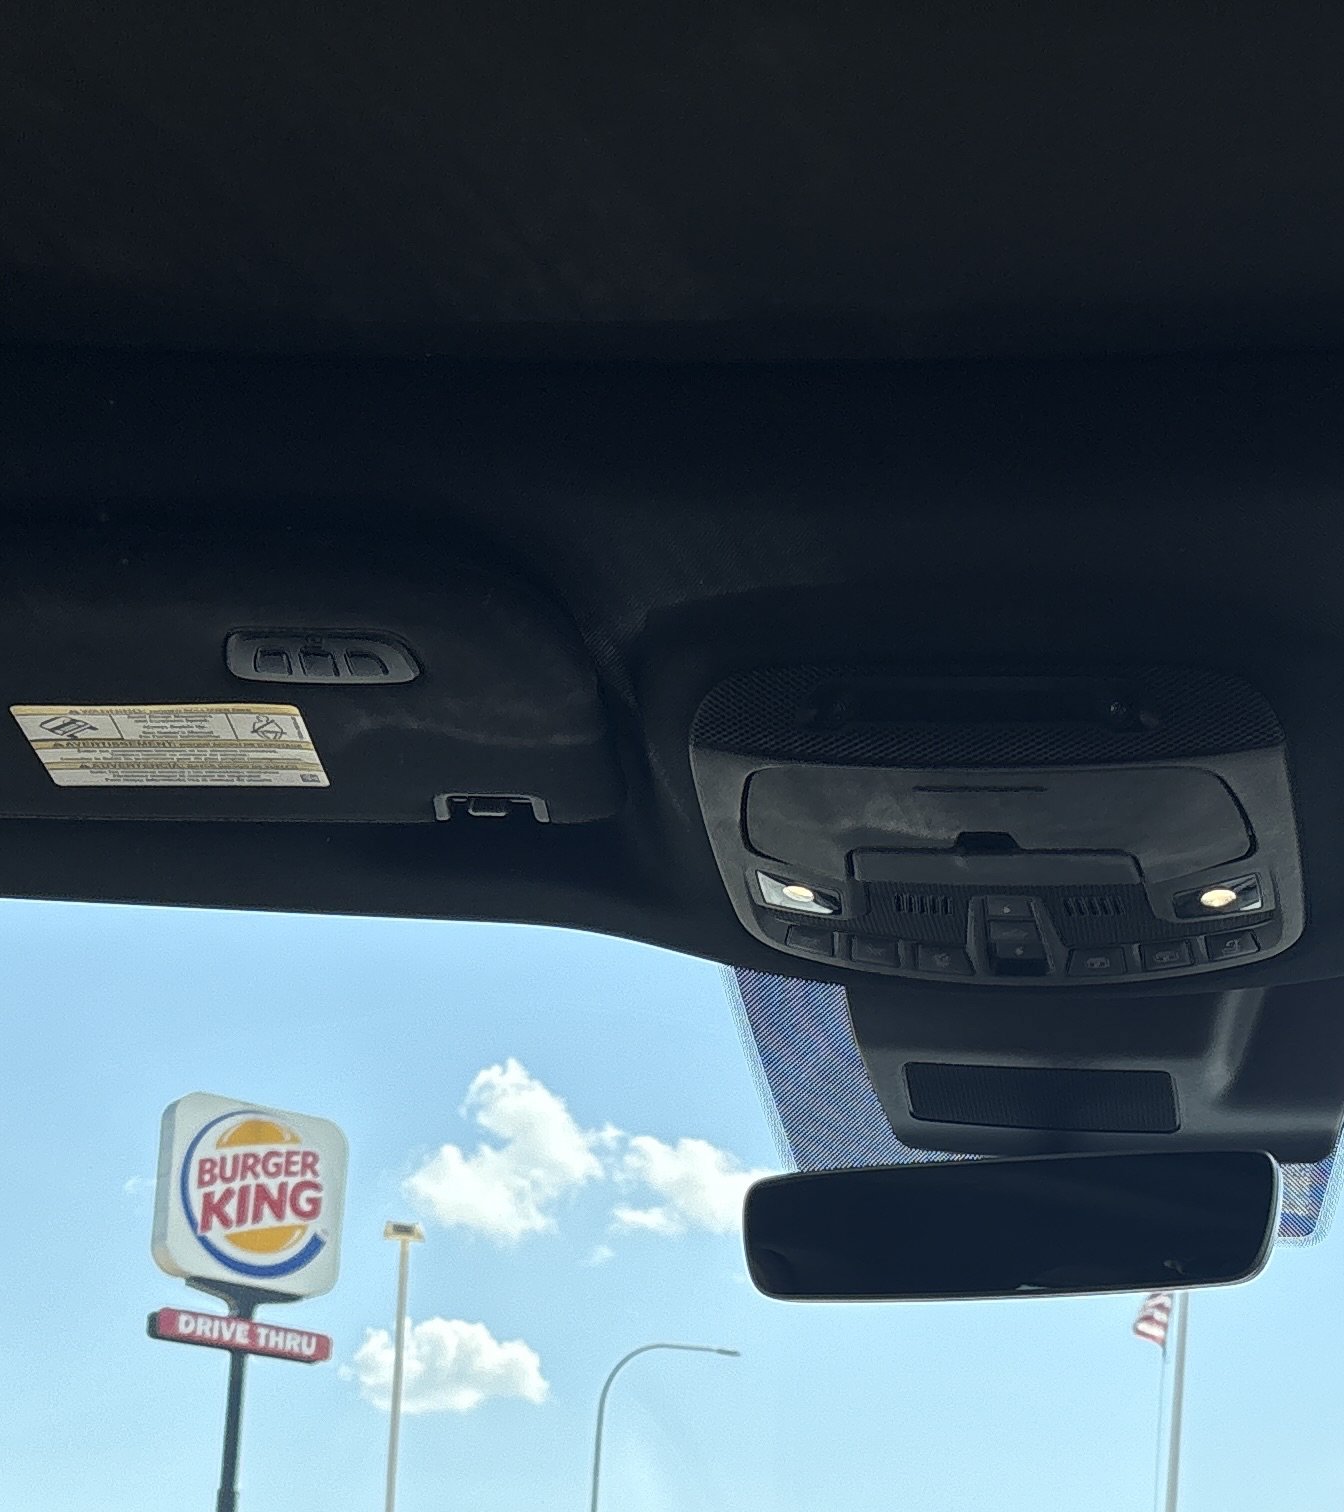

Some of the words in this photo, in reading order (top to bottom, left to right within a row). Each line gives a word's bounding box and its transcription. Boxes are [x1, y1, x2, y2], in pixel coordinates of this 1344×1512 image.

[197, 1150, 320, 1189] BURGER
[199, 1180, 324, 1234] KING
[178, 1313, 249, 1343] DRIVE
[257, 1328, 317, 1356] THRU
